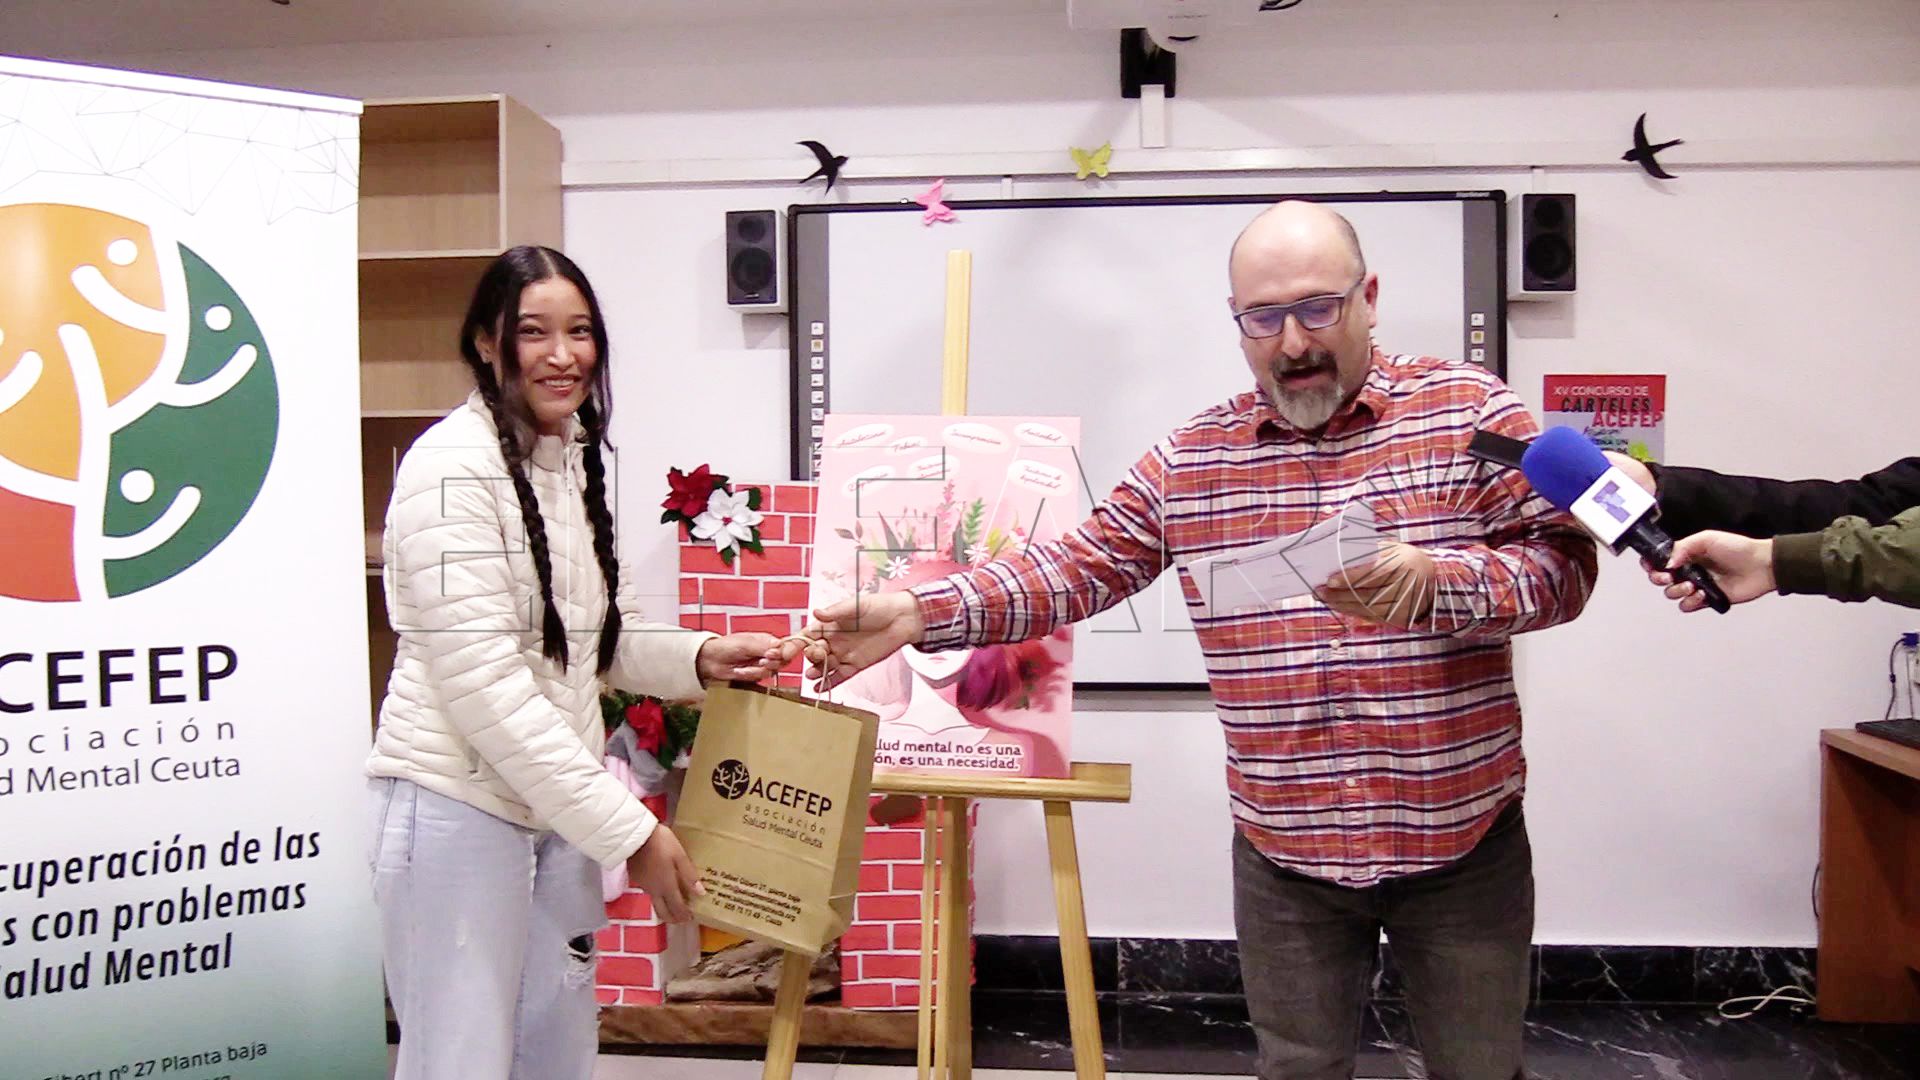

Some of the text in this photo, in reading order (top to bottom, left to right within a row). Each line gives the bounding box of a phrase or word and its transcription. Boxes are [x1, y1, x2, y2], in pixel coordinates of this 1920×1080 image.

[1561, 397, 1651, 412] CARTELES
[1571, 386, 1631, 396] CONCURSO
[1633, 386, 1649, 396] DE
[1592, 410, 1664, 427] ACEFEP
[874, 752, 1019, 769] ón, es una necesidad.
[875, 739, 1021, 756] lud mental no es una
[27, 759, 139, 793] Mental
[151, 755, 241, 783] Ceuta
[748, 776, 832, 817] ACEFEP
[220, 830, 261, 867] de
[273, 826, 320, 862] las
[32, 908, 99, 942] con
[112, 881, 307, 942] problemas
[0, 932, 233, 1000] alud Mental
[134, 1060, 156, 1078] 27
[162, 1049, 222, 1072] Planta
[228, 1041, 268, 1061] baja
